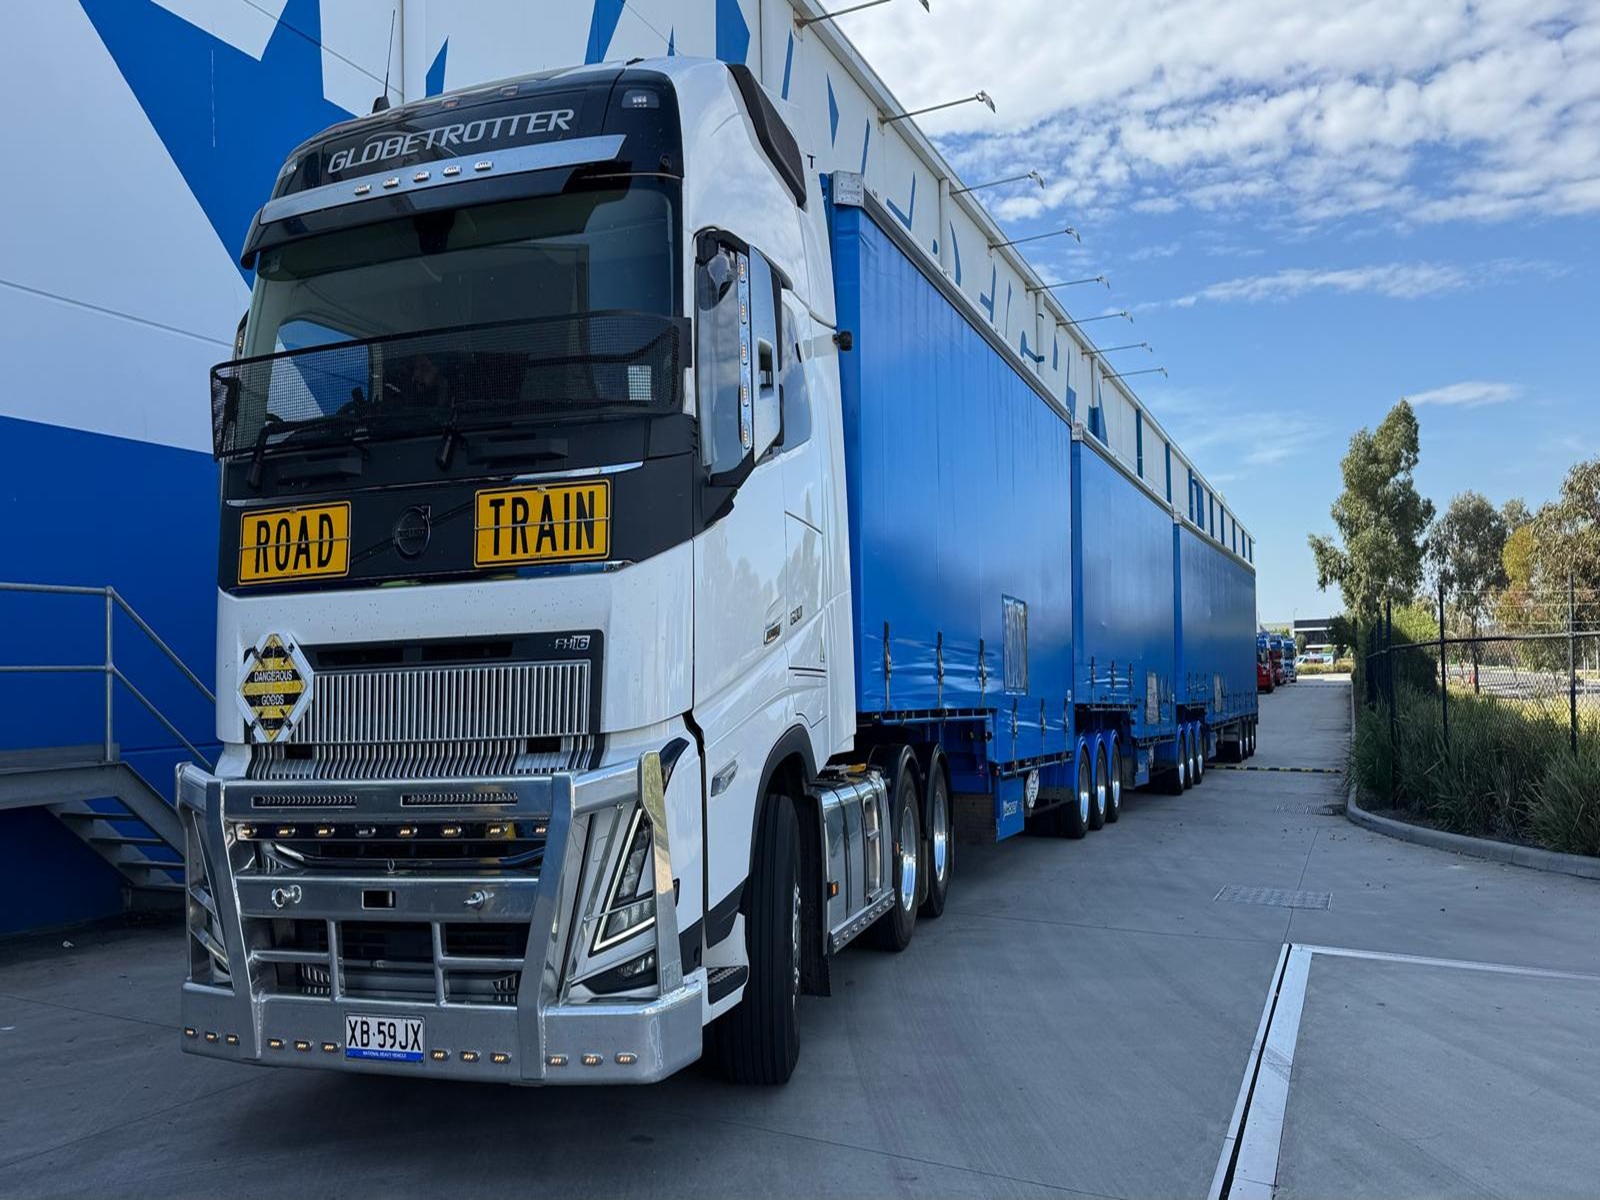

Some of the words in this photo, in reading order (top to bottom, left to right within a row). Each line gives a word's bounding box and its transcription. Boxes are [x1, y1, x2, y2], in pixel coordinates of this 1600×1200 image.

[327, 109, 575, 174] GLOBETROTTER
[254, 513, 335, 574] ROAD
[488, 491, 596, 556] TRAIN
[555, 634, 591, 650] FH16
[254, 670, 293, 682] DANGEROUS
[261, 694, 285, 706] GOODS
